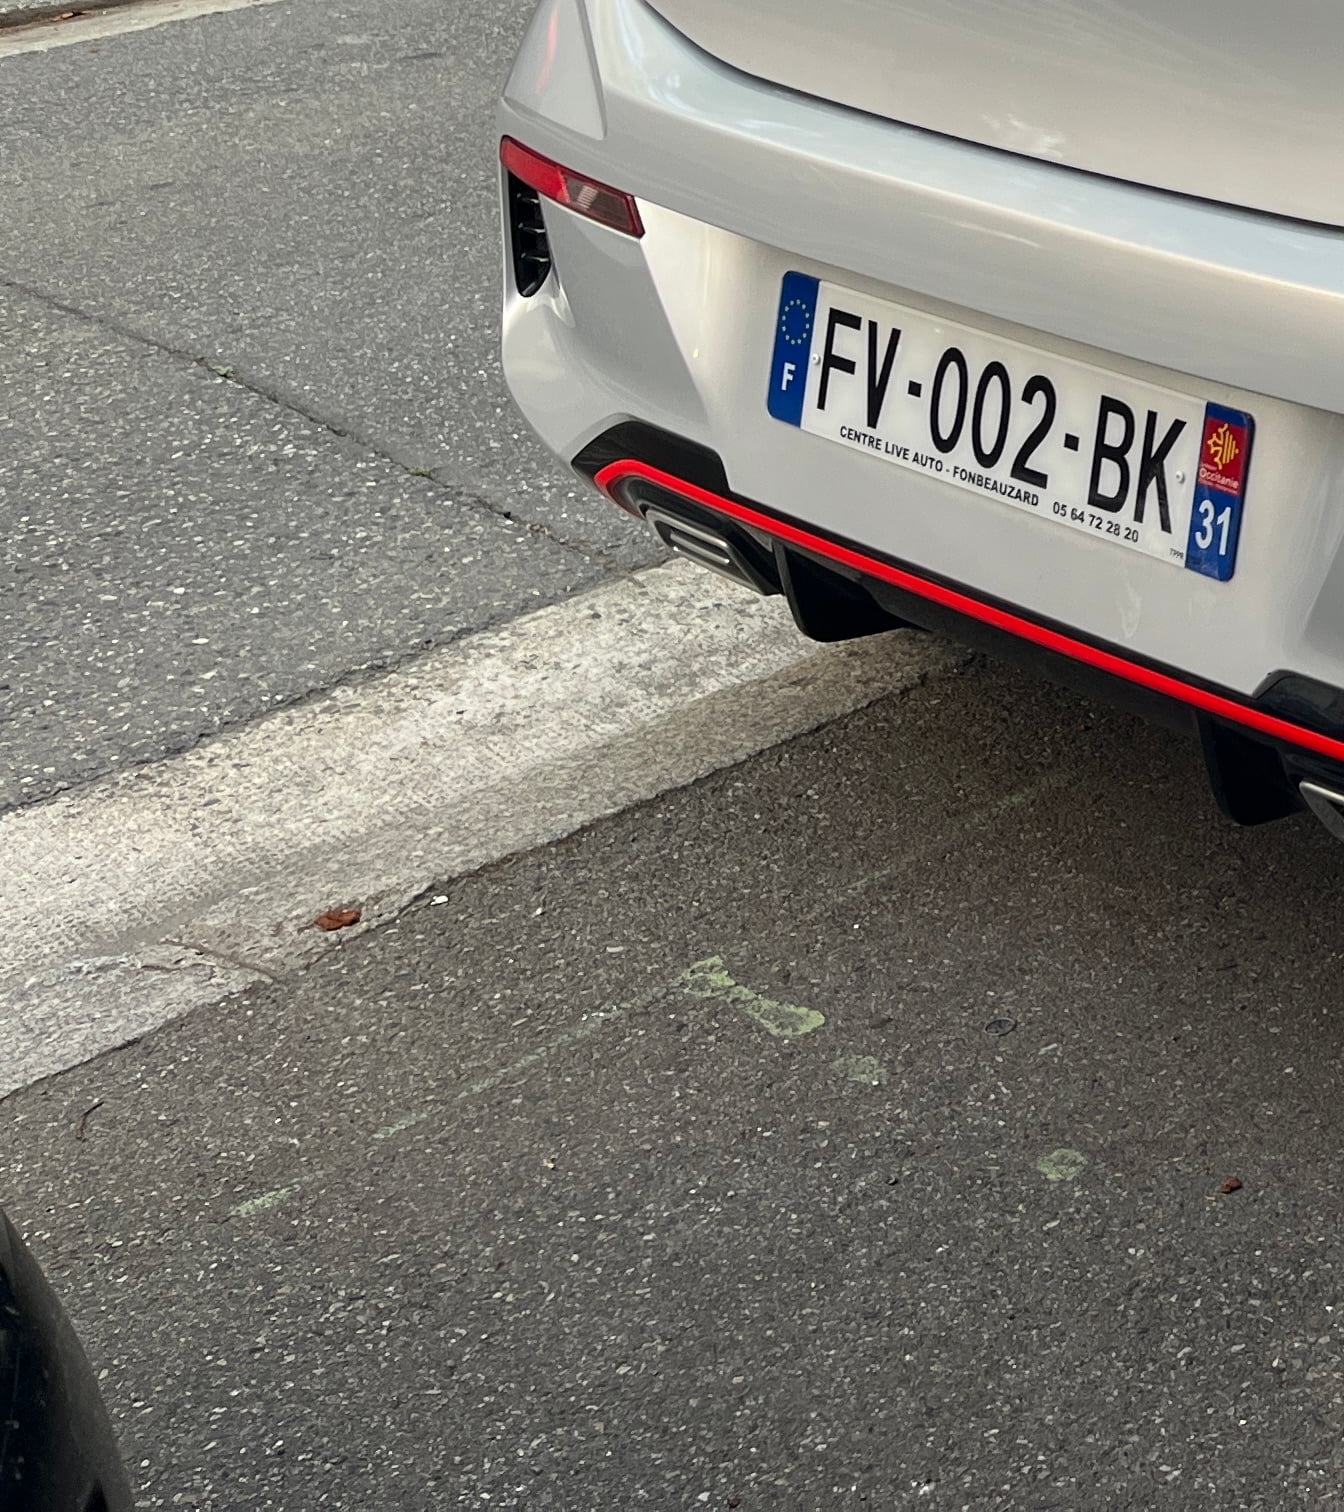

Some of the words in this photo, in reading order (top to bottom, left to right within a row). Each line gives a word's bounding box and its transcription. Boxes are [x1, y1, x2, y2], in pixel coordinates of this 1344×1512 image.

[780, 361, 796, 391] F
[816, 307, 1188, 535] FV-002-BK
[839, 425, 882, 451] CENTRE
[884, 441, 910, 461] LIVE
[912, 451, 944, 473] AUTO
[952, 465, 1040, 507] FONBEAUZARD
[1199, 467, 1240, 489] Occitanie
[1052, 501, 1068, 517] 05
[1070, 507, 1086, 523] 64
[1088, 513, 1103, 530] 72
[1106, 520, 1121, 536] 28
[1124, 526, 1139, 543] 20
[1194, 499, 1232, 556] 31
